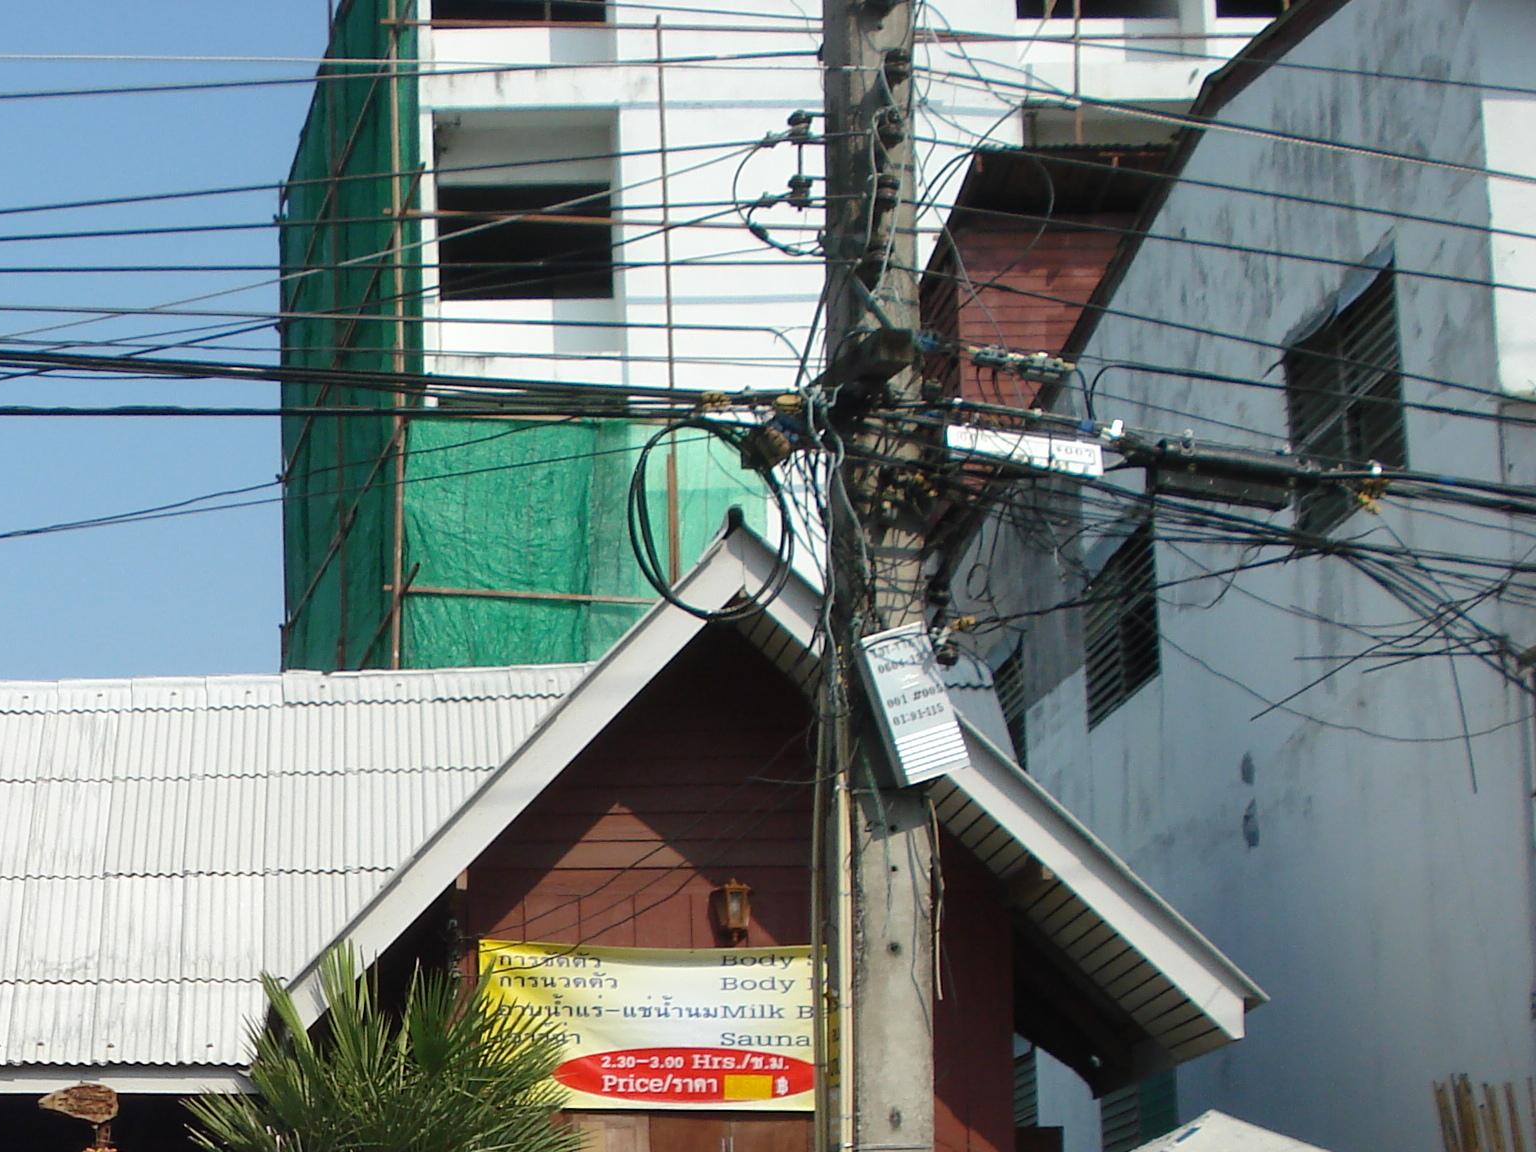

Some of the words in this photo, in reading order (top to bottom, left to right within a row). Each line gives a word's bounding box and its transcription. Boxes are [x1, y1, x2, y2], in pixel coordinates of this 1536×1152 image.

[720, 954, 795, 970] Body
[499, 972, 619, 990] การนวดตัว
[720, 975, 795, 993] Body
[720, 1003, 785, 1020] Milk
[720, 1031, 812, 1047] Sauna
